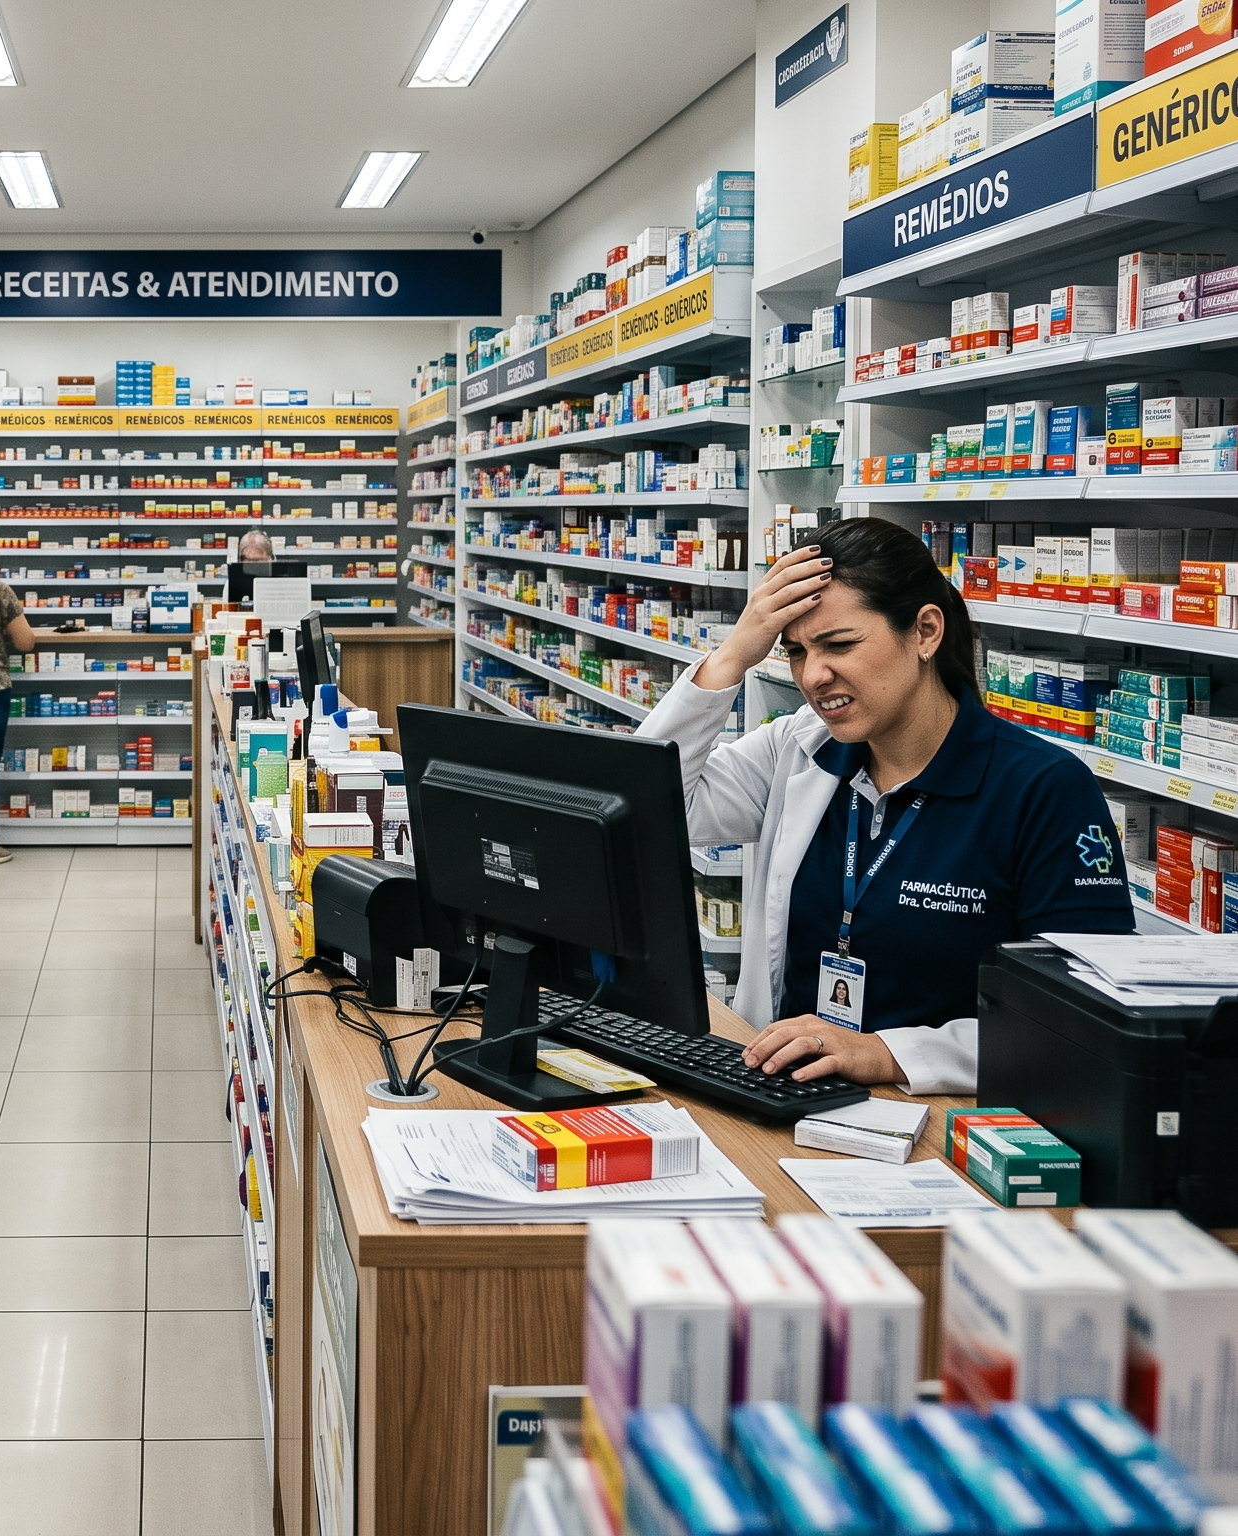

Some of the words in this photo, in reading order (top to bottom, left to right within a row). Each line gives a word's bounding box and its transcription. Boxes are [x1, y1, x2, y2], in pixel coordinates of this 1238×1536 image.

[895, 170, 1009, 248] REMÉDIOS
[136, 271, 160, 298] &
[167, 270, 399, 298] ATENDIMENTO
[898, 893, 920, 908] Dra.
[972, 902, 985, 914] M.
